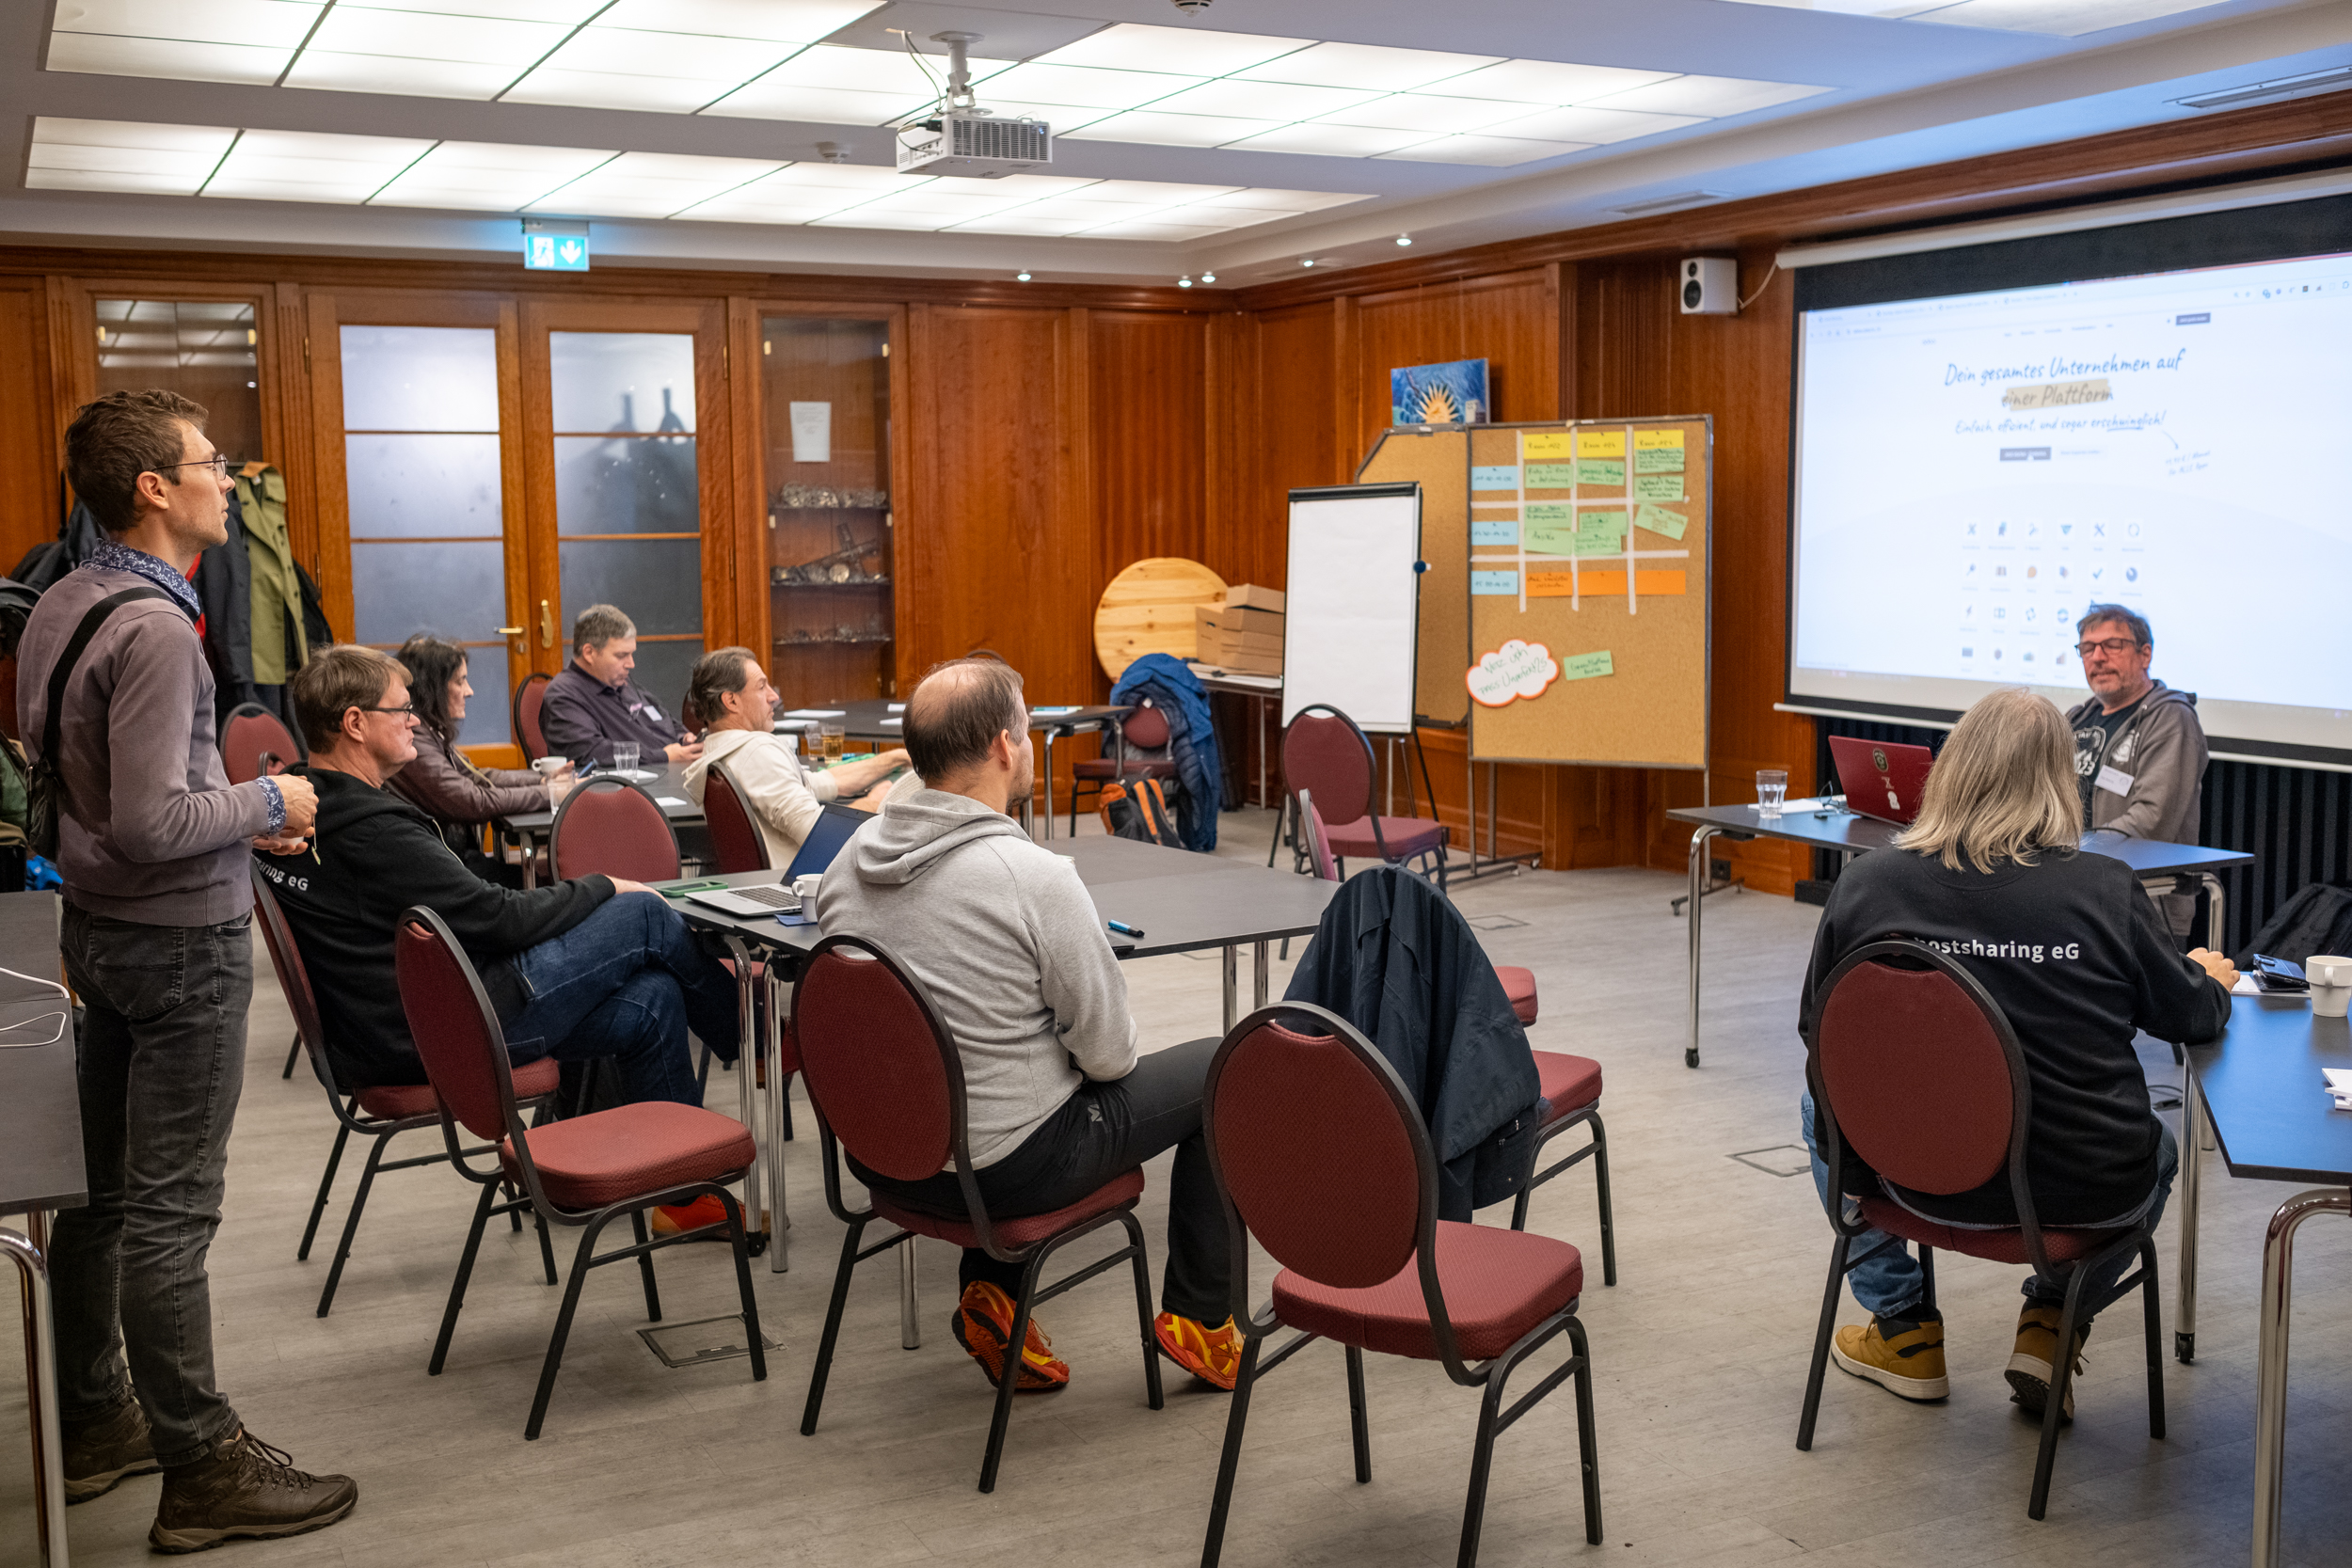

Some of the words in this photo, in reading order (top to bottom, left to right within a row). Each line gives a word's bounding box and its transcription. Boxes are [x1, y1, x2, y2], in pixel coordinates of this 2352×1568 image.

[1945, 363, 1977, 387] Dein
[1980, 363, 2044, 387] gesamtes
[2049, 354, 2151, 378] Unternehmen
[2156, 348, 2186, 371] auf
[2001, 390, 2037, 408] einer
[2041, 382, 2114, 407] Plattform
[2040, 418, 2059, 430] und
[2091, 410, 2167, 430] erschwinglich!
[288, 876, 309, 892] eG
[1914, 937, 2044, 964] ostsharing
[2051, 942, 2079, 959] eG
